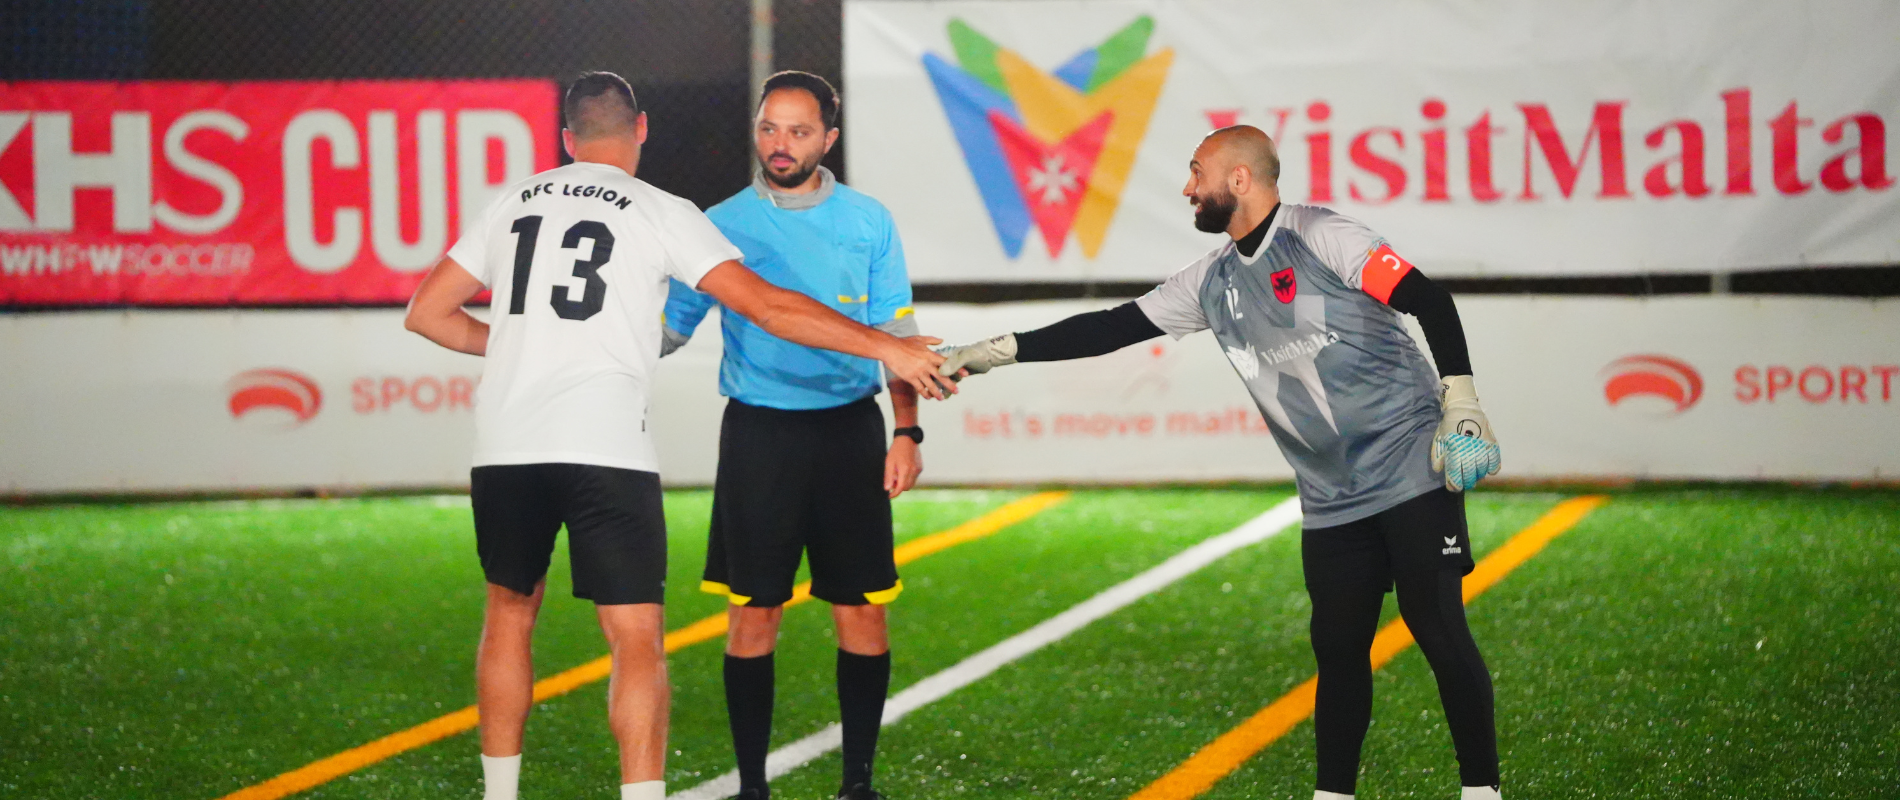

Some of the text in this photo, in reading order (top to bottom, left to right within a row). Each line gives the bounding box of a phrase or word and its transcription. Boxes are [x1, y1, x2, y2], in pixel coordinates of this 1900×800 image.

[281, 108, 536, 274] CUP
[521, 182, 632, 210] AFC LEGION
[509, 214, 616, 321] 13
[1260, 331, 1340, 366] VisitMalta
[350, 375, 483, 414] SPOR
[1734, 364, 1900, 404] SPORT
[1052, 412, 1156, 437] move
